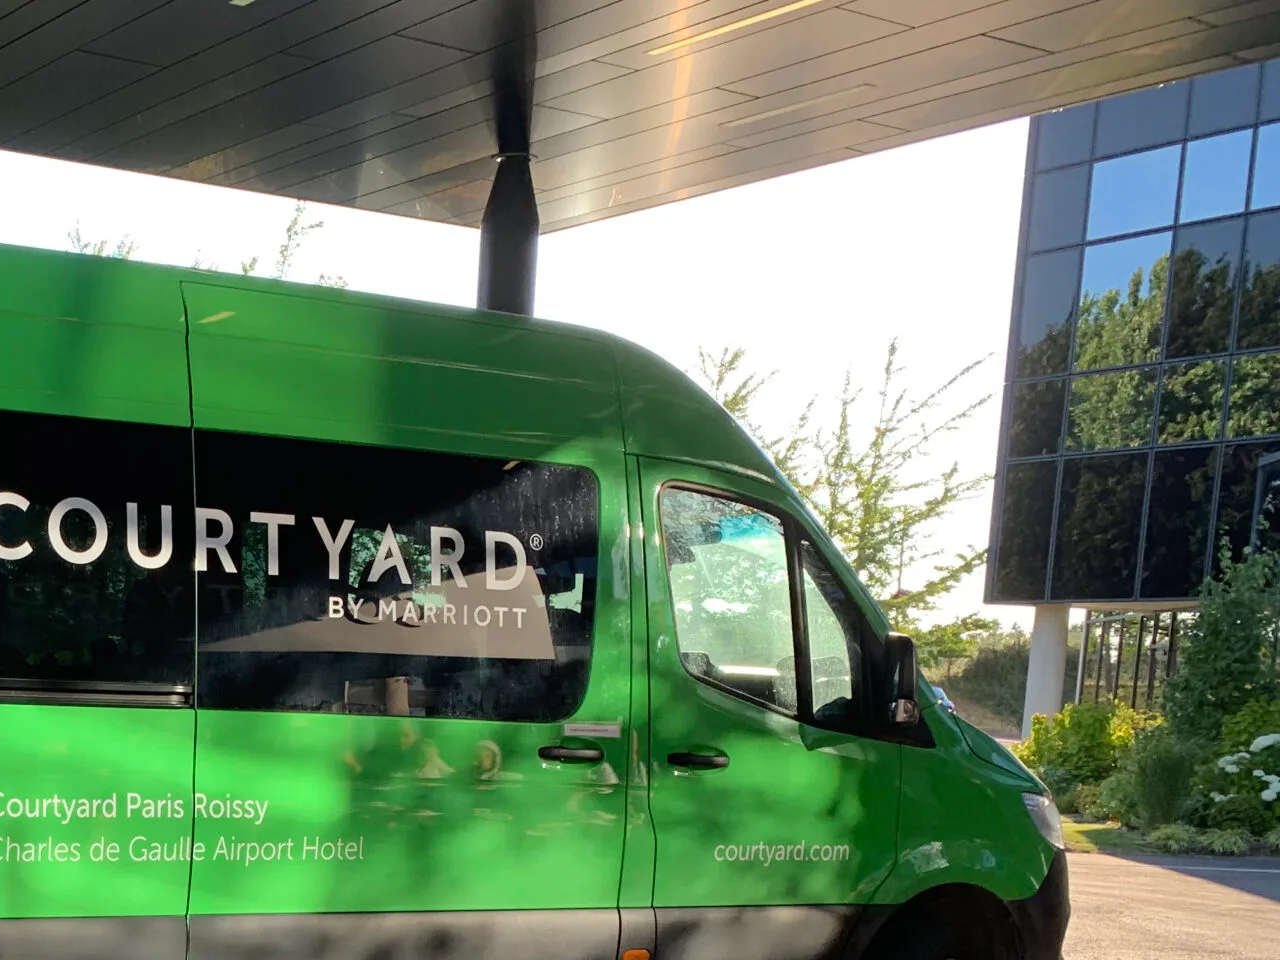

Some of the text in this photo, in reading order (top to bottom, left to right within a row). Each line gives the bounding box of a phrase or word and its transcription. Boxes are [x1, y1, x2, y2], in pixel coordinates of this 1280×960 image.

[328, 596, 528, 629] BY MARRIOTT
[127, 792, 185, 818] Paris
[193, 793, 269, 825] Roissy
[89, 836, 120, 862] de
[128, 836, 206, 861] Gaulle
[212, 836, 294, 867] Airport
[302, 836, 364, 860] Hotel
[714, 839, 850, 867] courtyard.com
